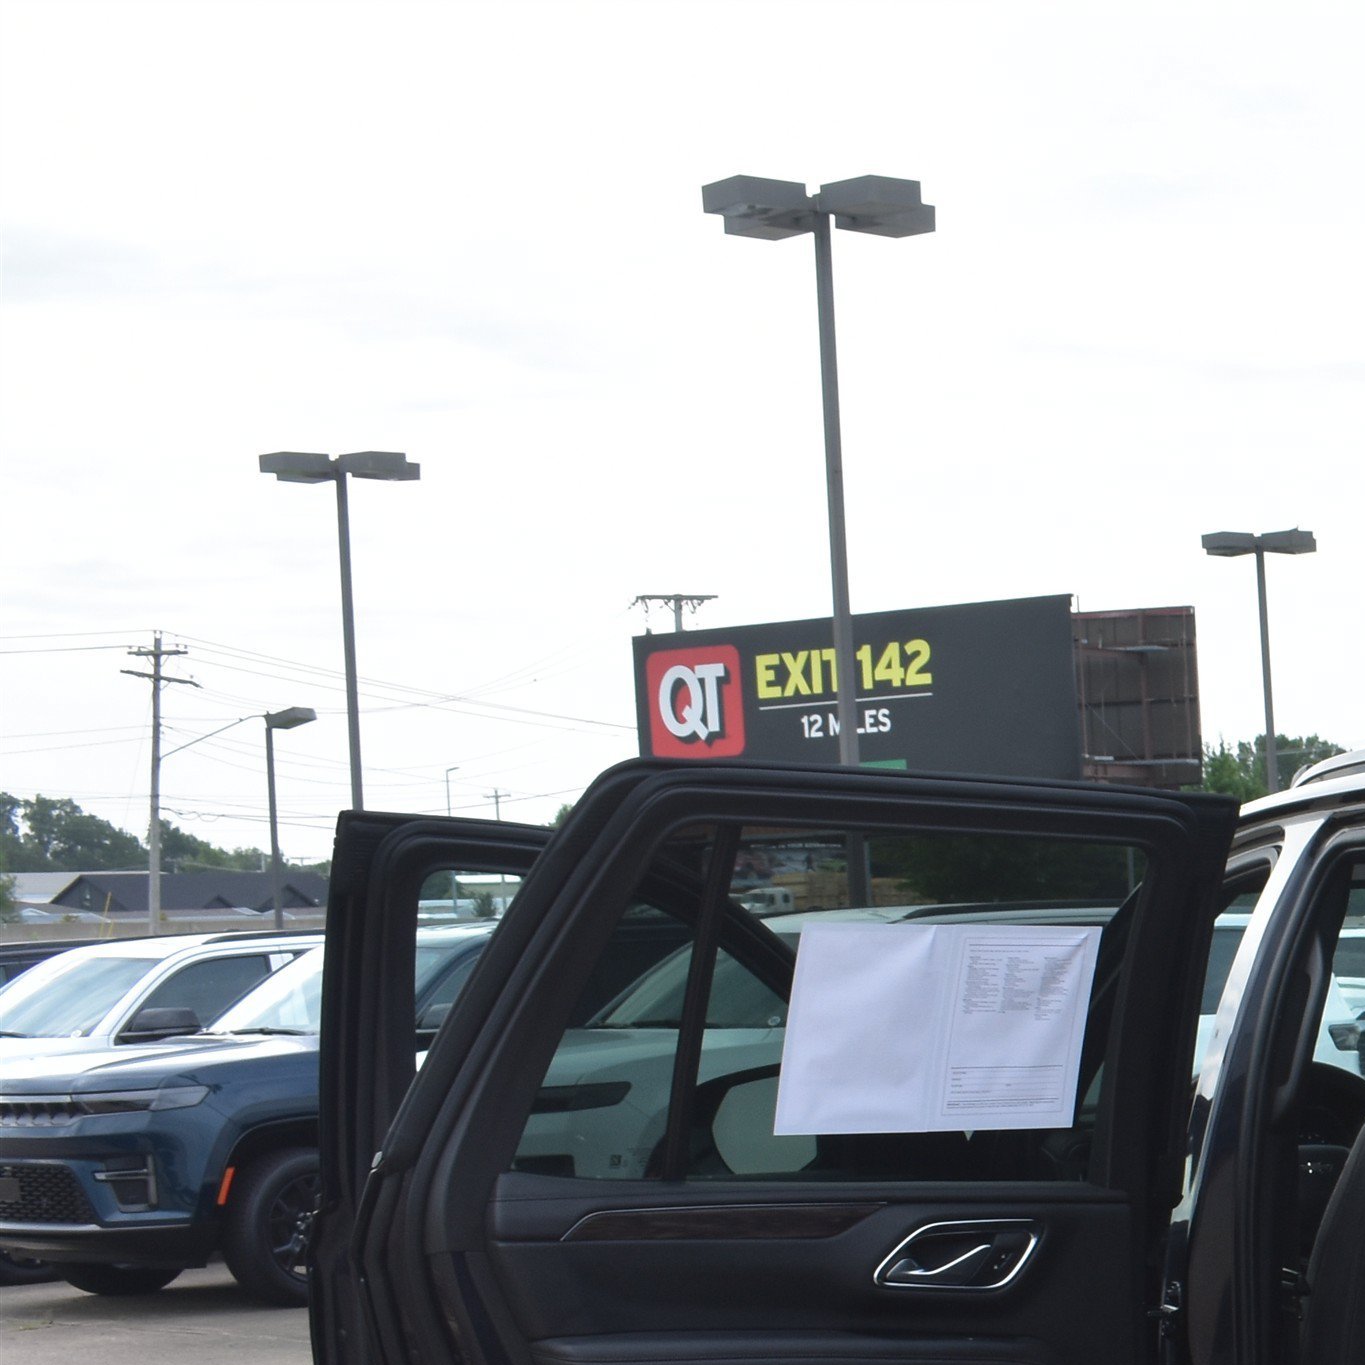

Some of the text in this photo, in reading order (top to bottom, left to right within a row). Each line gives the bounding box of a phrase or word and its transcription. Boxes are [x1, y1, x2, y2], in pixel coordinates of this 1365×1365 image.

[755, 638, 933, 699] EXIT 142
[658, 664, 726, 742] QT
[800, 708, 892, 739] 12 MES
